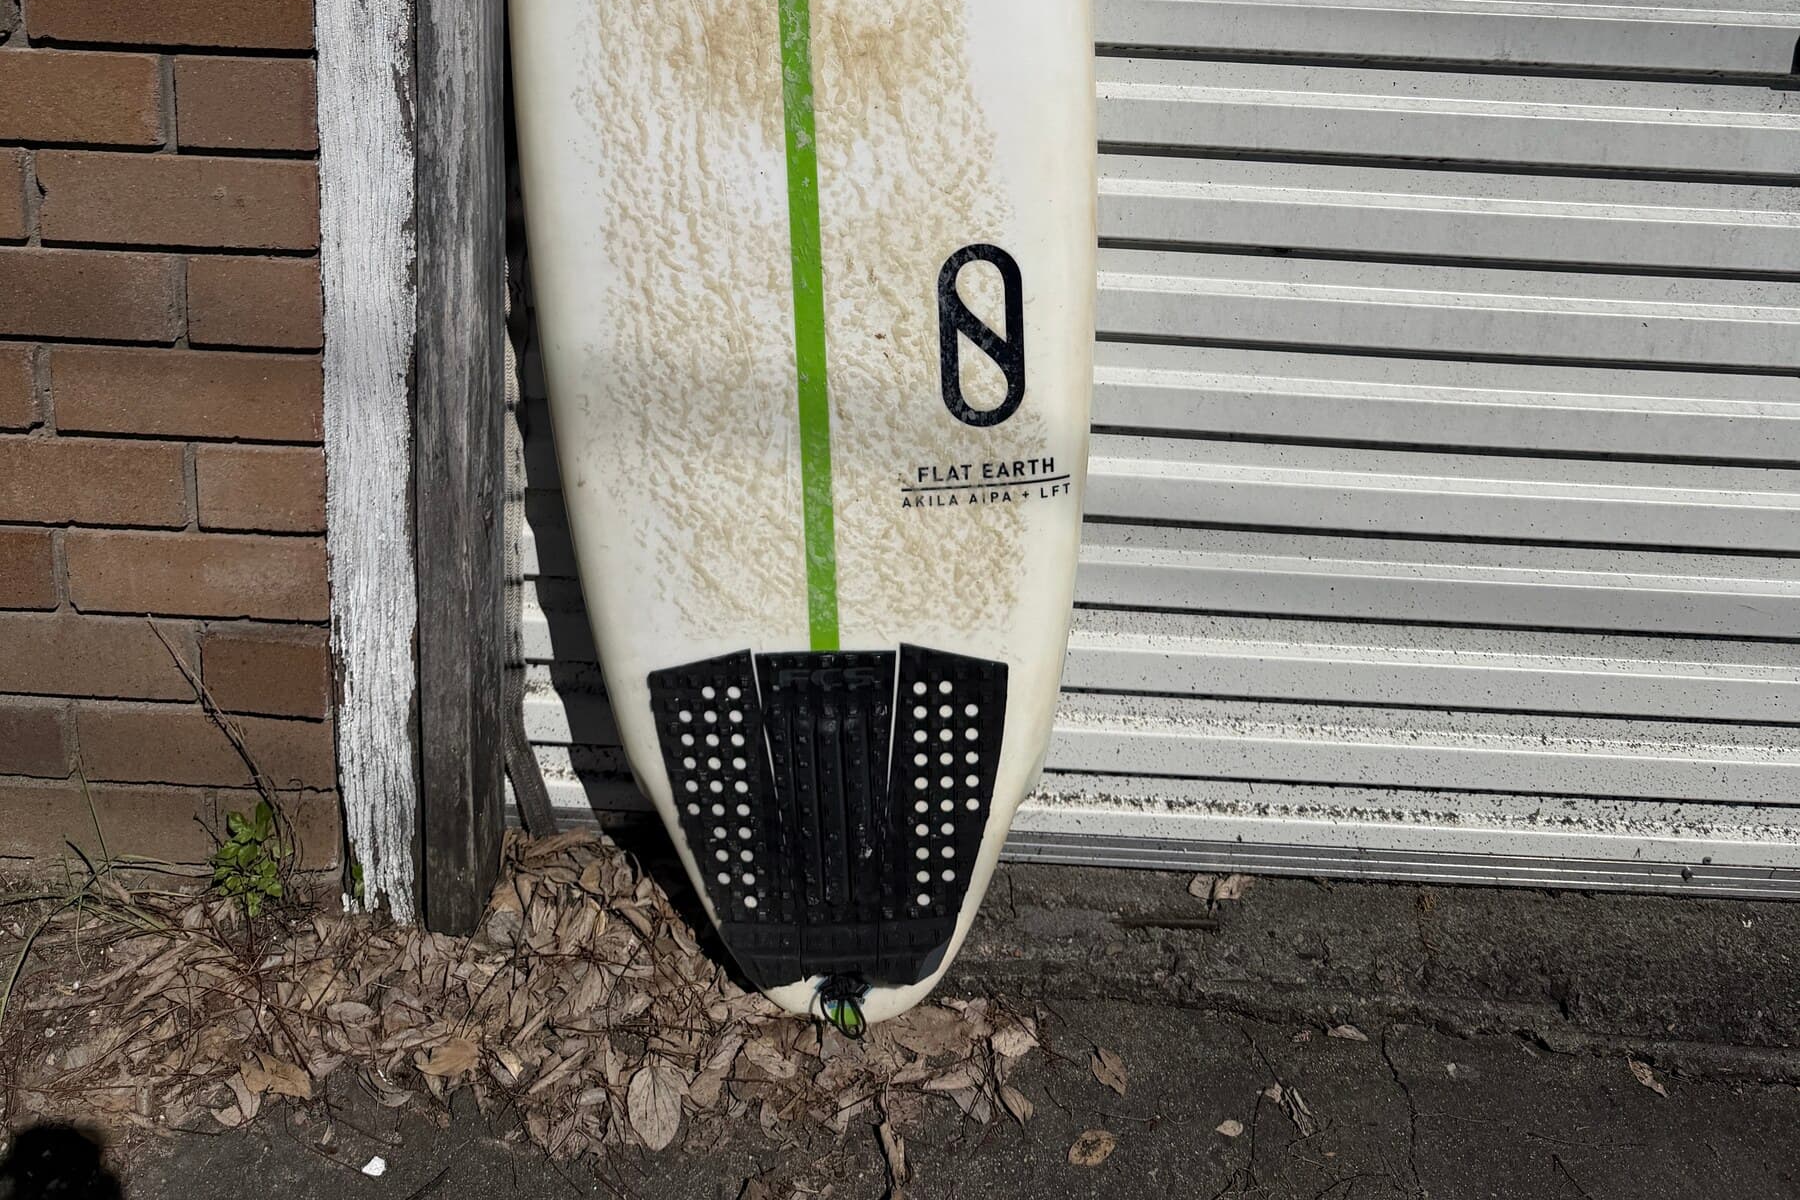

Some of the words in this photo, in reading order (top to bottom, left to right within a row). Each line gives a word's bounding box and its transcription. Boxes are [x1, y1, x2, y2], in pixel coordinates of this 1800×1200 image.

[917, 464, 972, 482] FLAT
[982, 457, 1055, 479] EARTH
[902, 494, 959, 508] AKILA
[969, 491, 1012, 504] AIPA
[1022, 490, 1030, 498] +
[1040, 483, 1071, 498] LFT
[779, 667, 876, 688] FCS
